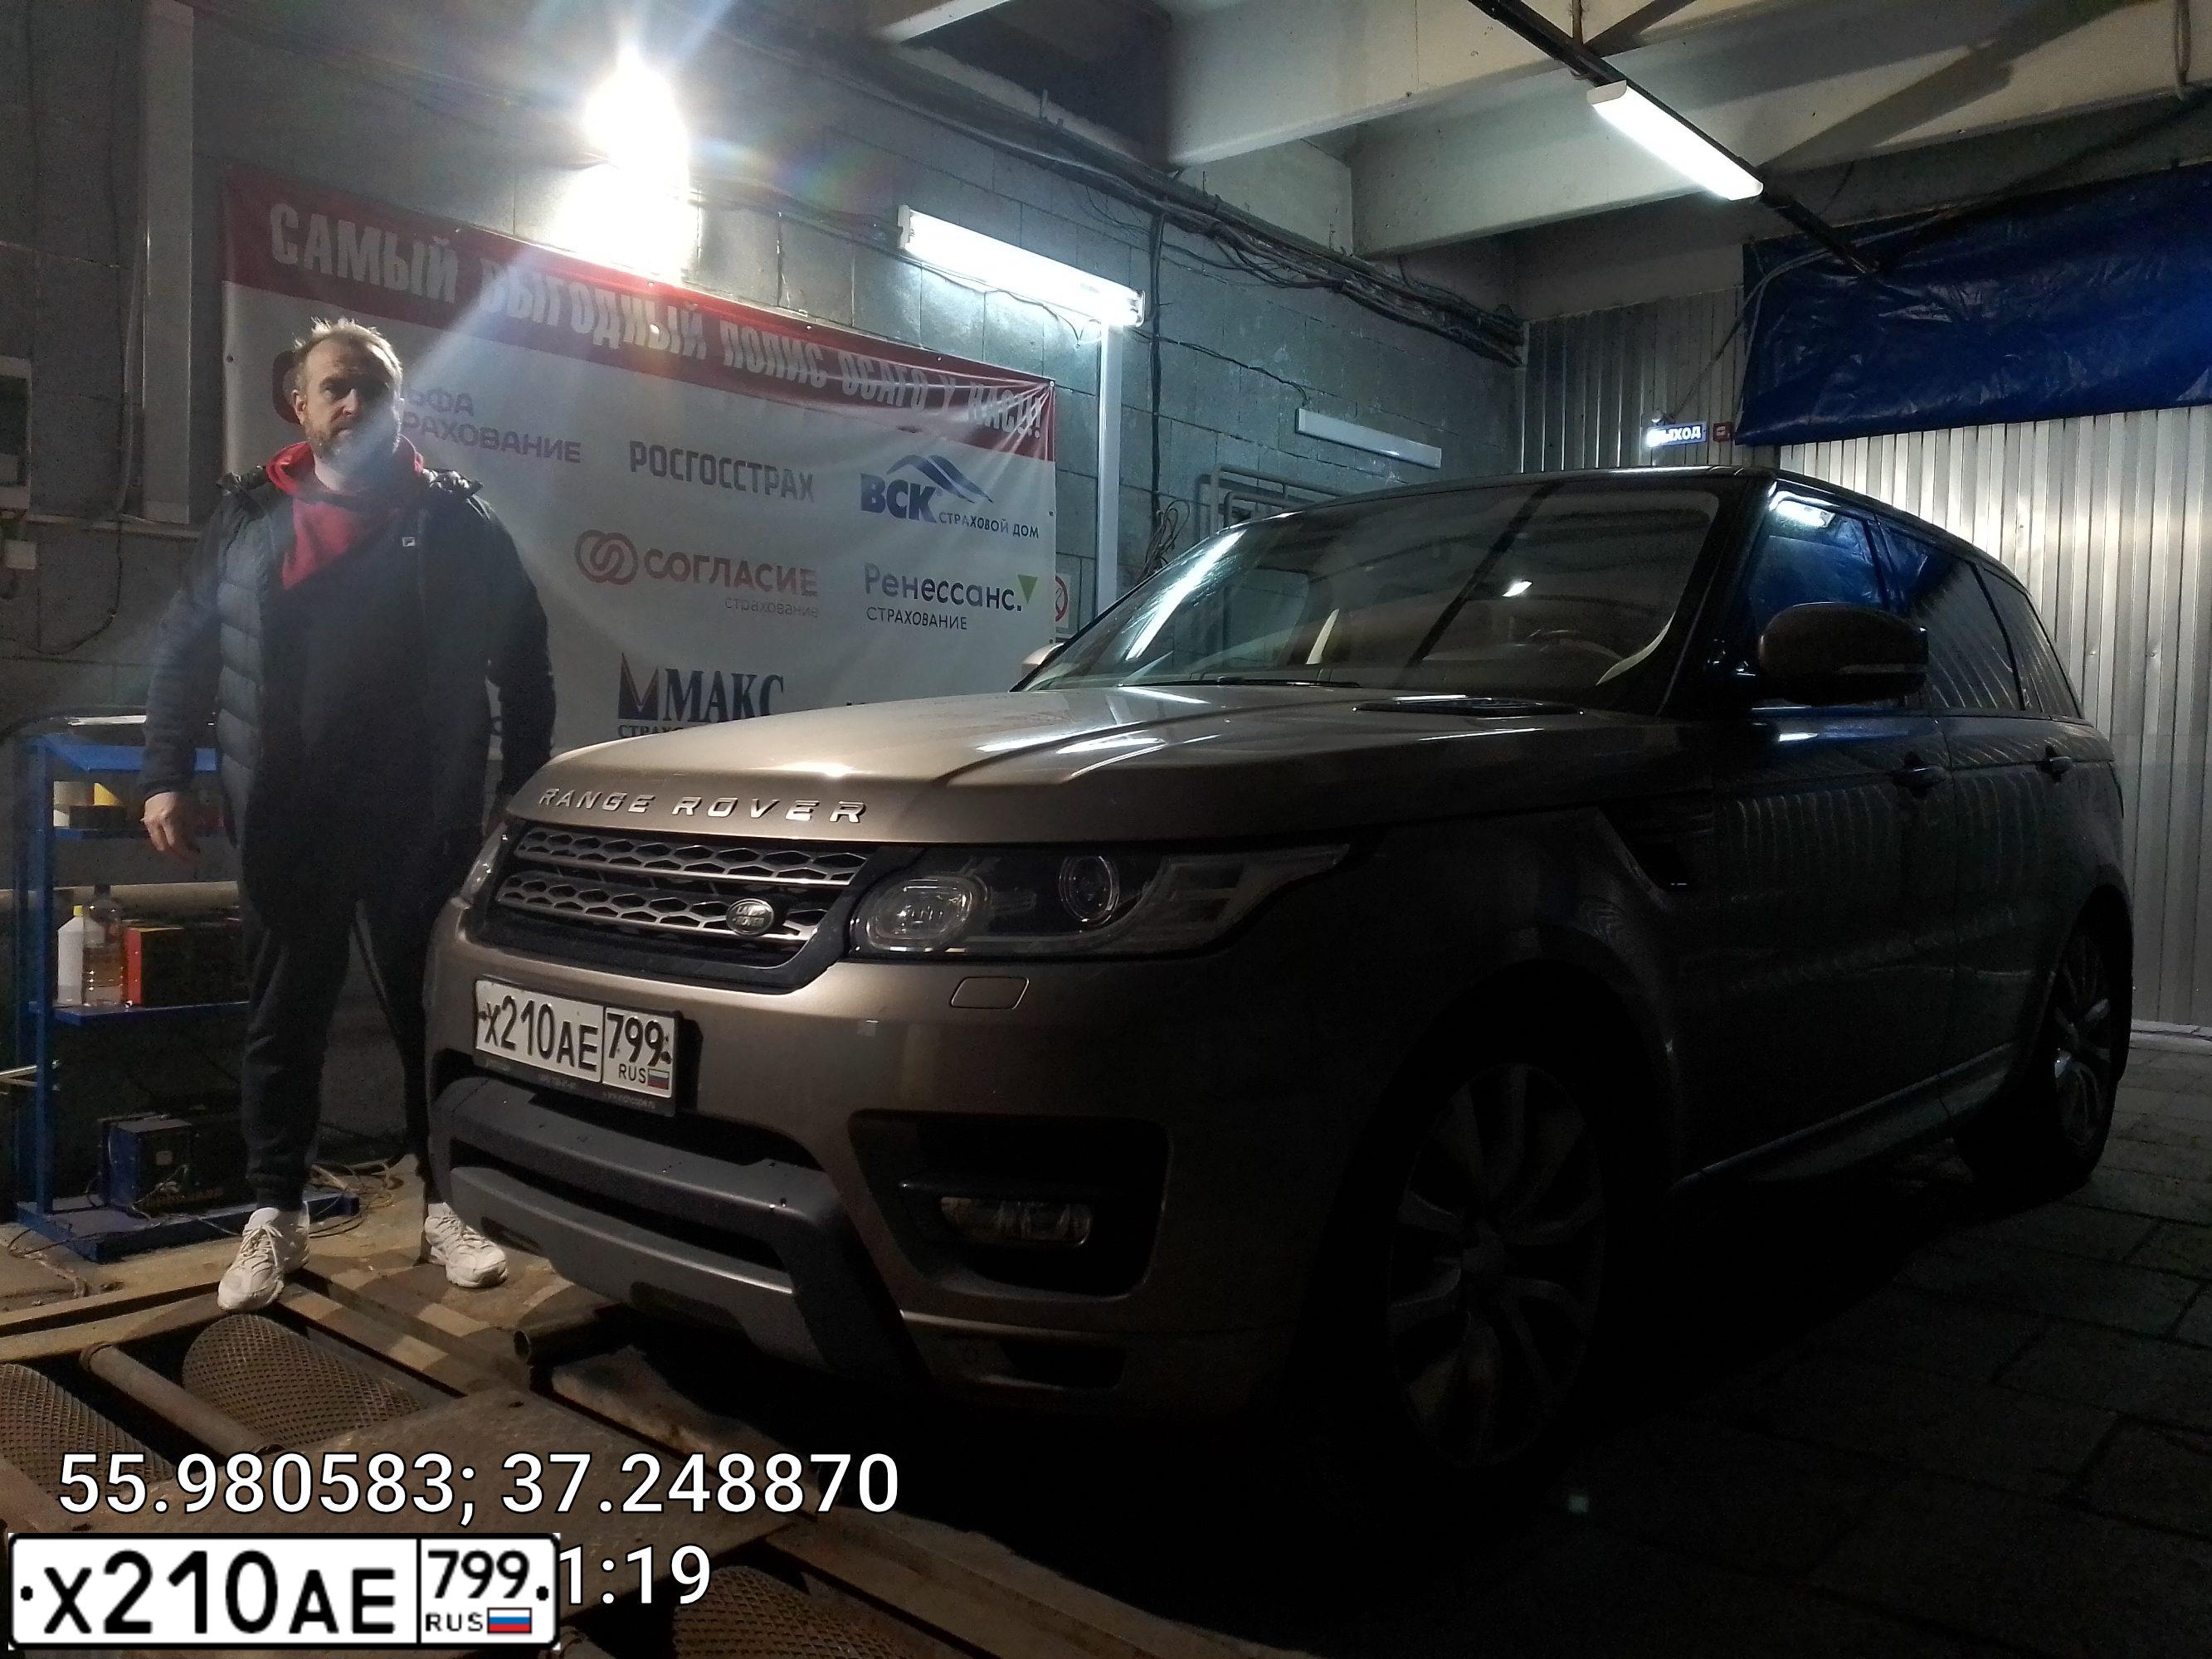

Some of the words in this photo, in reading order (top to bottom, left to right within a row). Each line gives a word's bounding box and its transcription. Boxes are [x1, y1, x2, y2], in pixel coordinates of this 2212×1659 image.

[270, 202, 457, 303] САМЫЙ
[480, 257, 707, 361] ВЫГОДНЫЙ
[720, 319, 828, 389] ПОЛИС
[838, 352, 928, 412] ОСАГО
[939, 374, 956, 411] У
[403, 411, 582, 464] РАХОВАНИЕ
[1648, 426, 1702, 445] ЫХОД
[630, 440, 815, 502] РОСГОССТРАХ
[860, 473, 938, 524] ВСК
[938, 512, 1010, 533] СТРАХОВОЙ
[1012, 523, 1040, 539] ДОМ
[644, 547, 818, 597] СОГЛАСИЕ
[724, 597, 819, 618] страхование
[866, 606, 967, 630] СТРАХОВАНИЕ
[538, 788, 655, 814] RANGE
[671, 796, 867, 824] ROVER
[607, 1013, 665, 1068] 799
[618, 1064, 646, 1083] RUS
